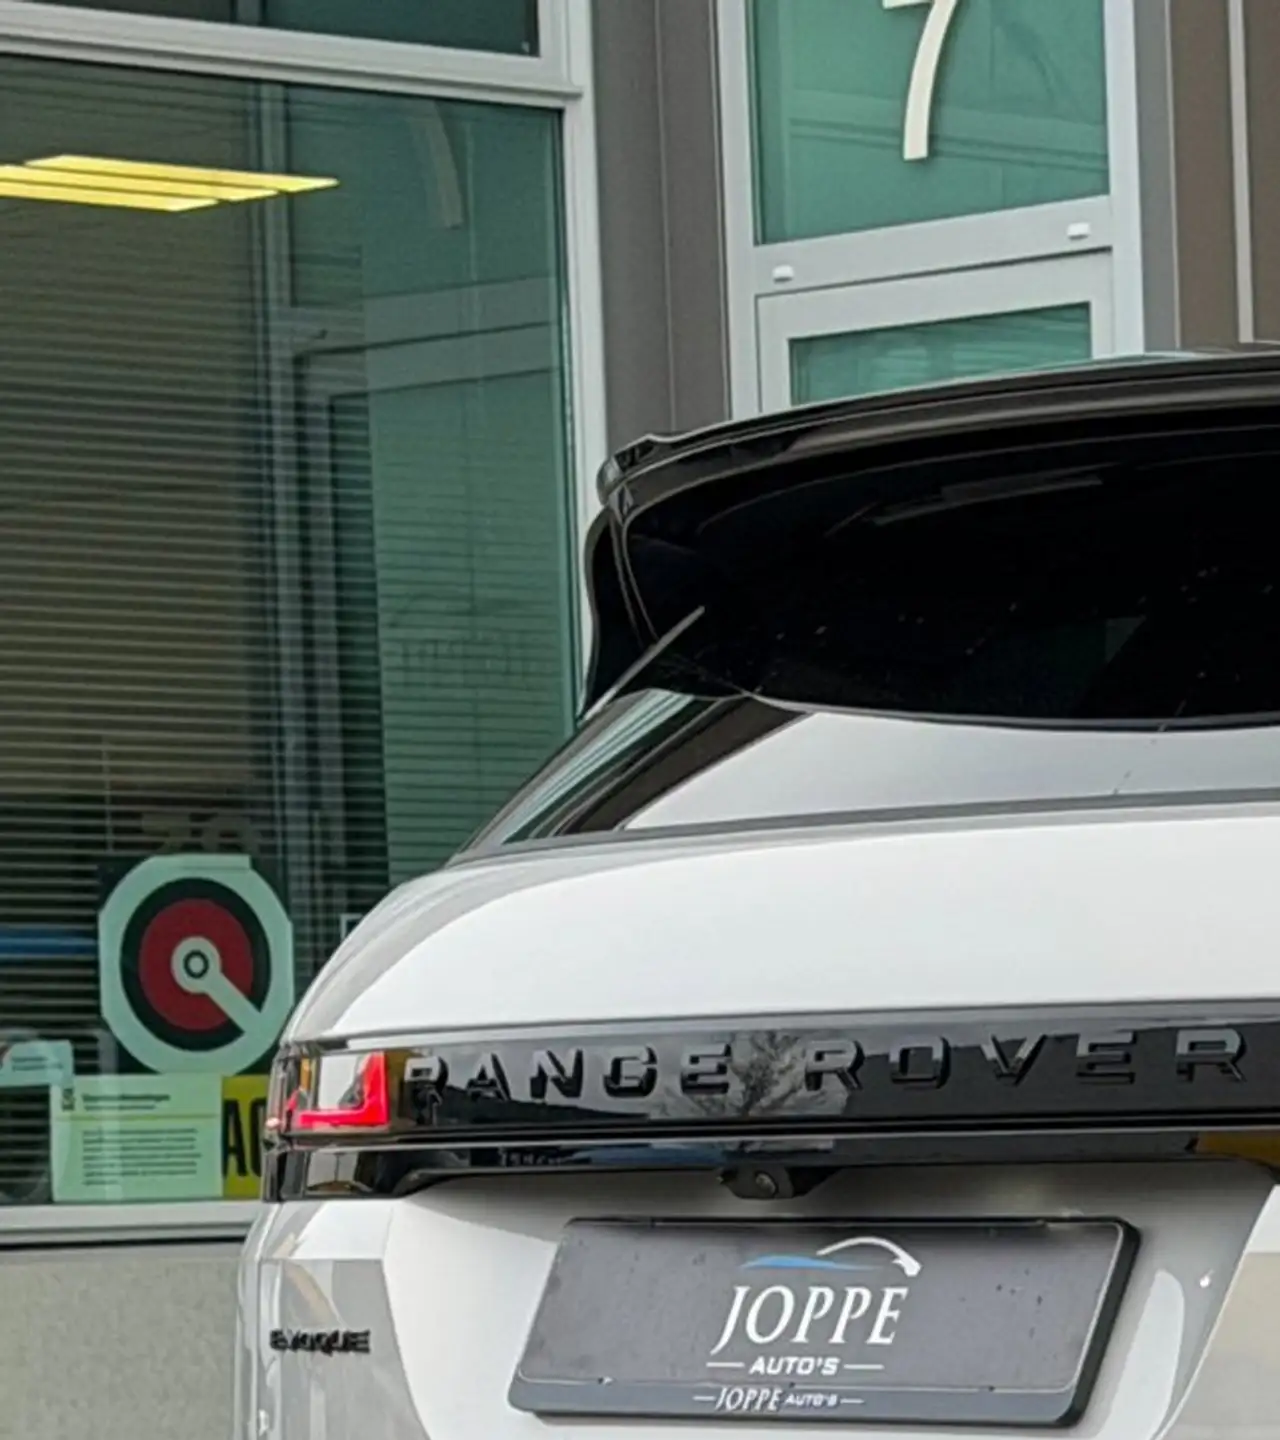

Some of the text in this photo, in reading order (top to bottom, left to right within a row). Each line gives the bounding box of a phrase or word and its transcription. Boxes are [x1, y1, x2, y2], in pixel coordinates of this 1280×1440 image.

[882, 0, 959, 161] 7
[404, 1028, 1246, 1108] RANGE ROVER
[710, 1284, 909, 1355] JOPPE
[715, 1386, 839, 1412] JOPPE AUTO'S
[748, 1356, 840, 1376] AUTO'S
